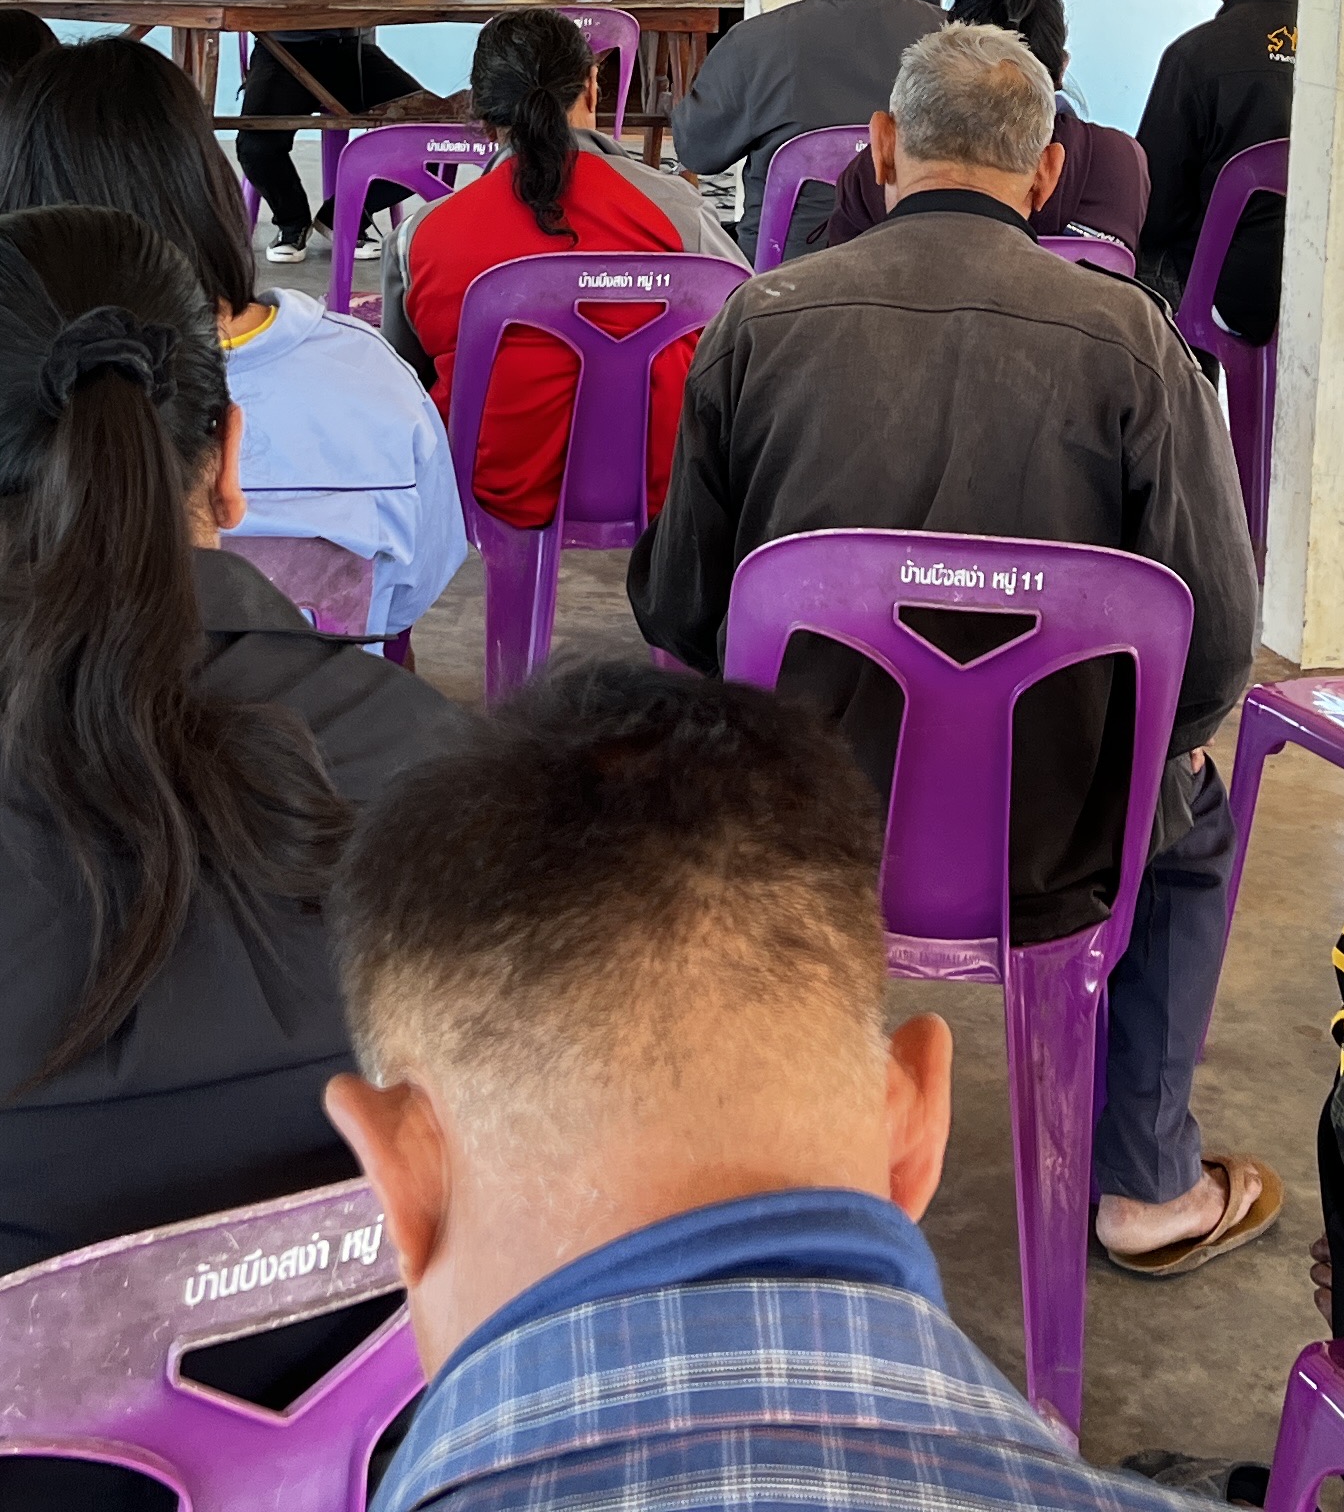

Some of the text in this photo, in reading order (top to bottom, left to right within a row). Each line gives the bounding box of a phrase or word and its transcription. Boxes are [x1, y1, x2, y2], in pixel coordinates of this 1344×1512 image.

[578, 271, 670, 291] บ้านบึงสง่า หมู่ 11
[900, 560, 1044, 595] บ้านบึงสง่า หมู่ 11
[184, 1213, 385, 1306] บ้านบึงสง่า หมู่
